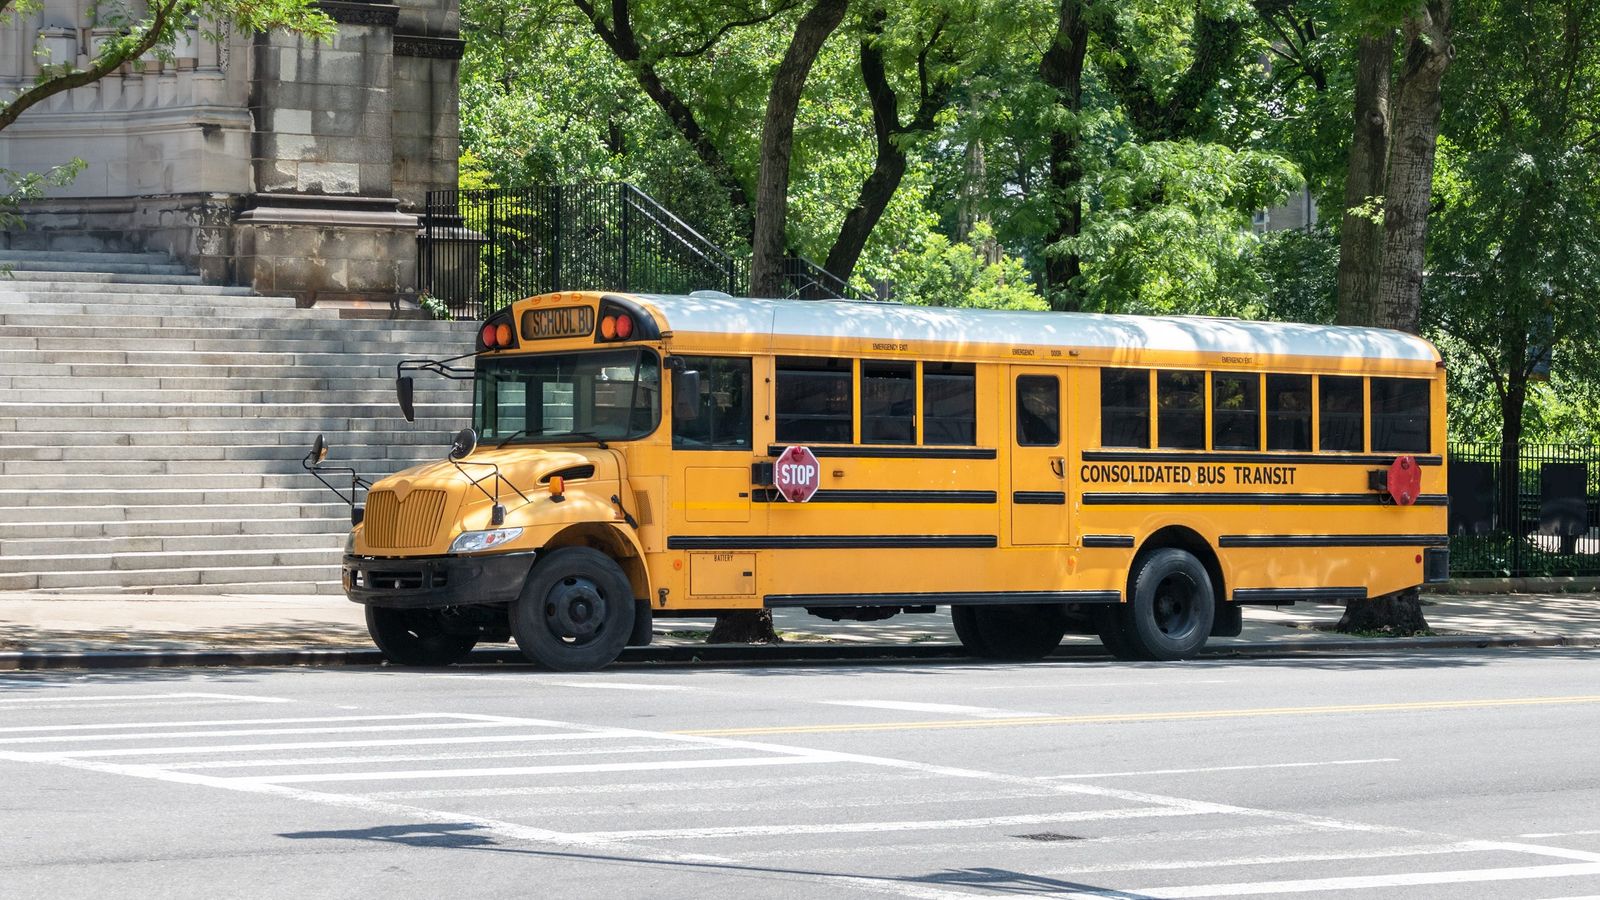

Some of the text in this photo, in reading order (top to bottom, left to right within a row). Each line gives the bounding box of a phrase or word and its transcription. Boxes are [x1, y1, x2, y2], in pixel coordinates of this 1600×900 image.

[533, 309, 576, 336] SCHOOL
[872, 343, 897, 351] EMERGENCY
[1011, 348, 1035, 356] EMERGENCY
[1221, 356, 1243, 364] EMERGENCY
[781, 464, 815, 485] STOP
[1080, 465, 1297, 485] CONSOLIDATED BUS TRANSIT
